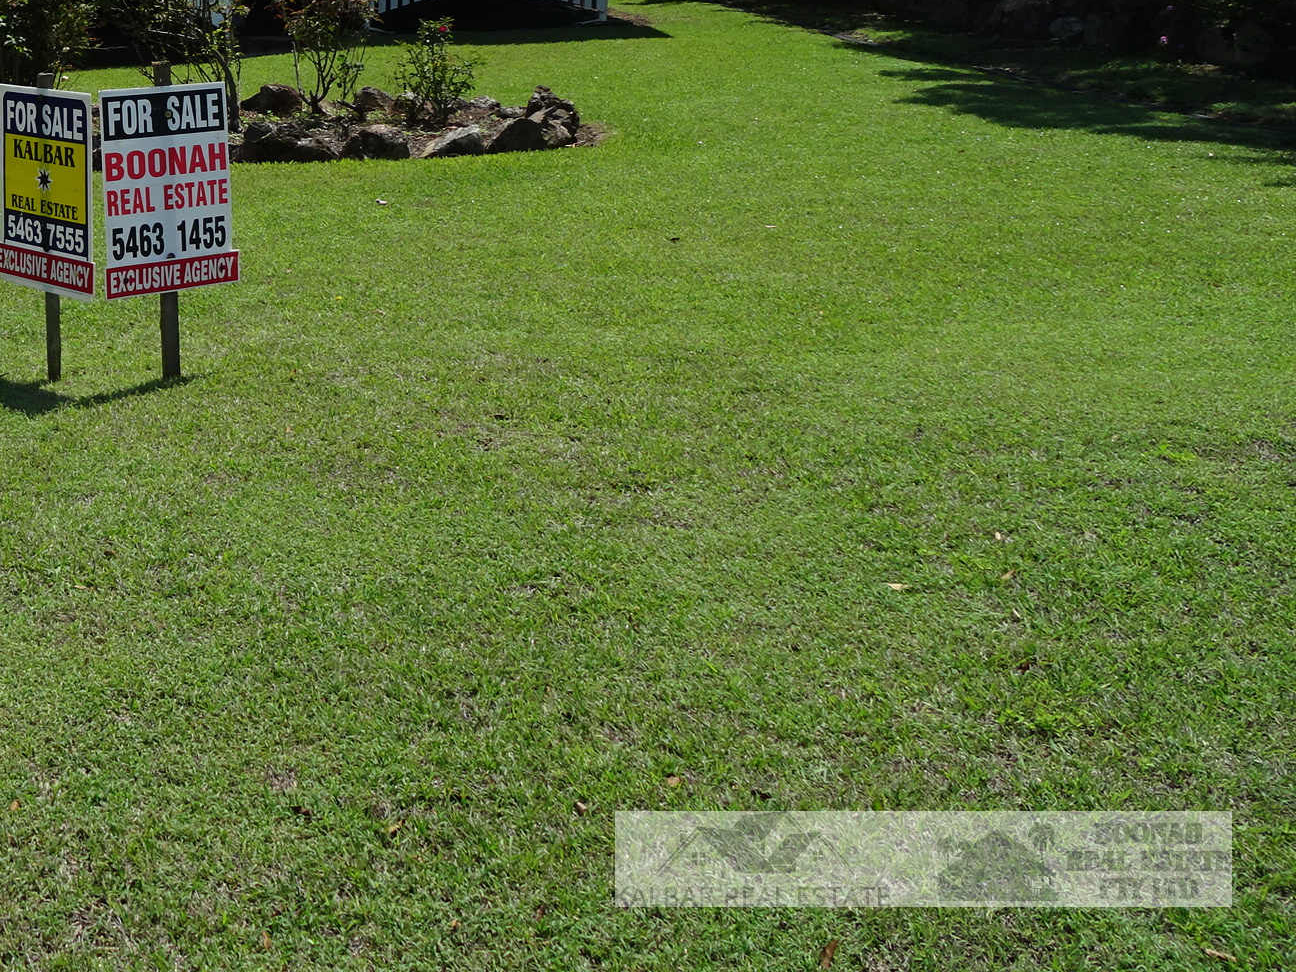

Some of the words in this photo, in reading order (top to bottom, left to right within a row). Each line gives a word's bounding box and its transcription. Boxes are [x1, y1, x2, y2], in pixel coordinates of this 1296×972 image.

[6, 100, 37, 134] FOR
[42, 104, 83, 140] SALE
[108, 99, 153, 136] FOR
[166, 93, 220, 131] SALE
[13, 138, 75, 167] KALBAR
[104, 142, 227, 182] BOONAH
[11, 194, 36, 211] REAL
[40, 199, 78, 220] ESTATE
[106, 186, 155, 217] REAL
[163, 178, 228, 210] ESTATE
[7, 214, 42, 244] 5463
[46, 223, 84, 254] 7555
[112, 222, 165, 261] 5463
[177, 215, 226, 252] 1455
[50, 259, 90, 288] AGENCY
[110, 263, 181, 295] EXCLUSIVE
[183, 256, 234, 285] AGENCY
